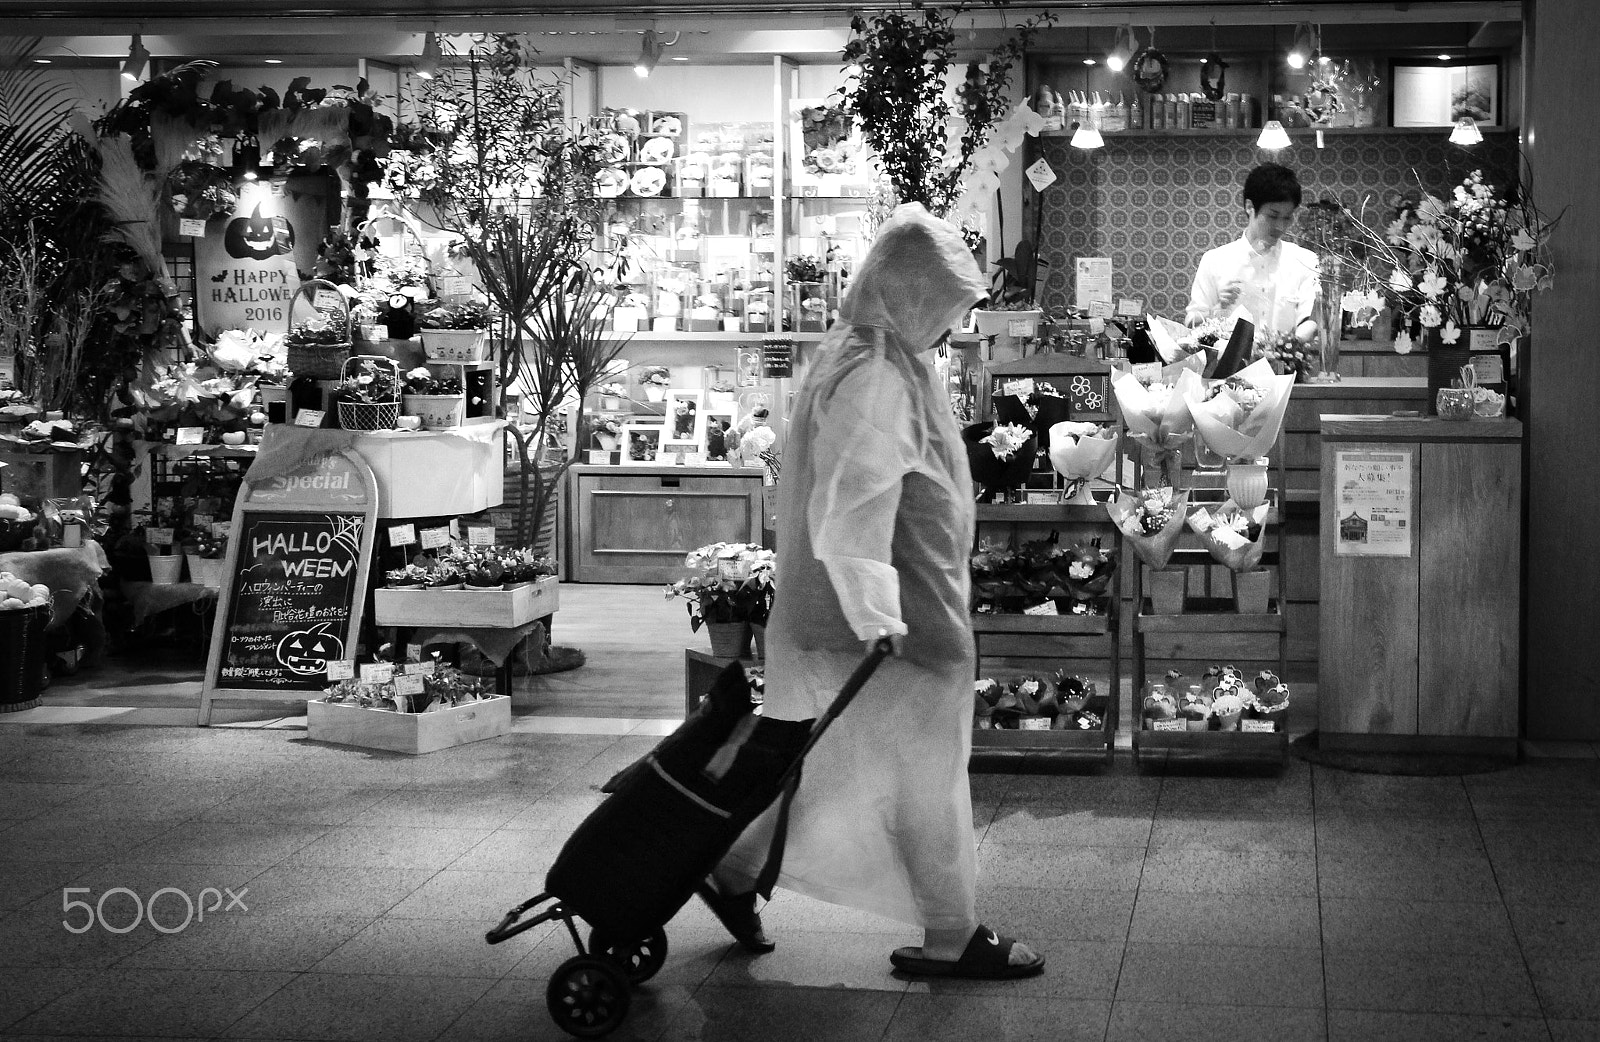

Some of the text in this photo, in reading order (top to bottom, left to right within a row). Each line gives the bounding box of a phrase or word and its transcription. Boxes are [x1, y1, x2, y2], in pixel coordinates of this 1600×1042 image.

[234, 269, 287, 285] HAPPY
[212, 287, 296, 303] HALLOWE
[245, 307, 283, 321] 2016
[252, 531, 331, 558] HALLO
[281, 558, 353, 577] WEEN
[240, 578, 324, 593] ハロウィンパーティーの
